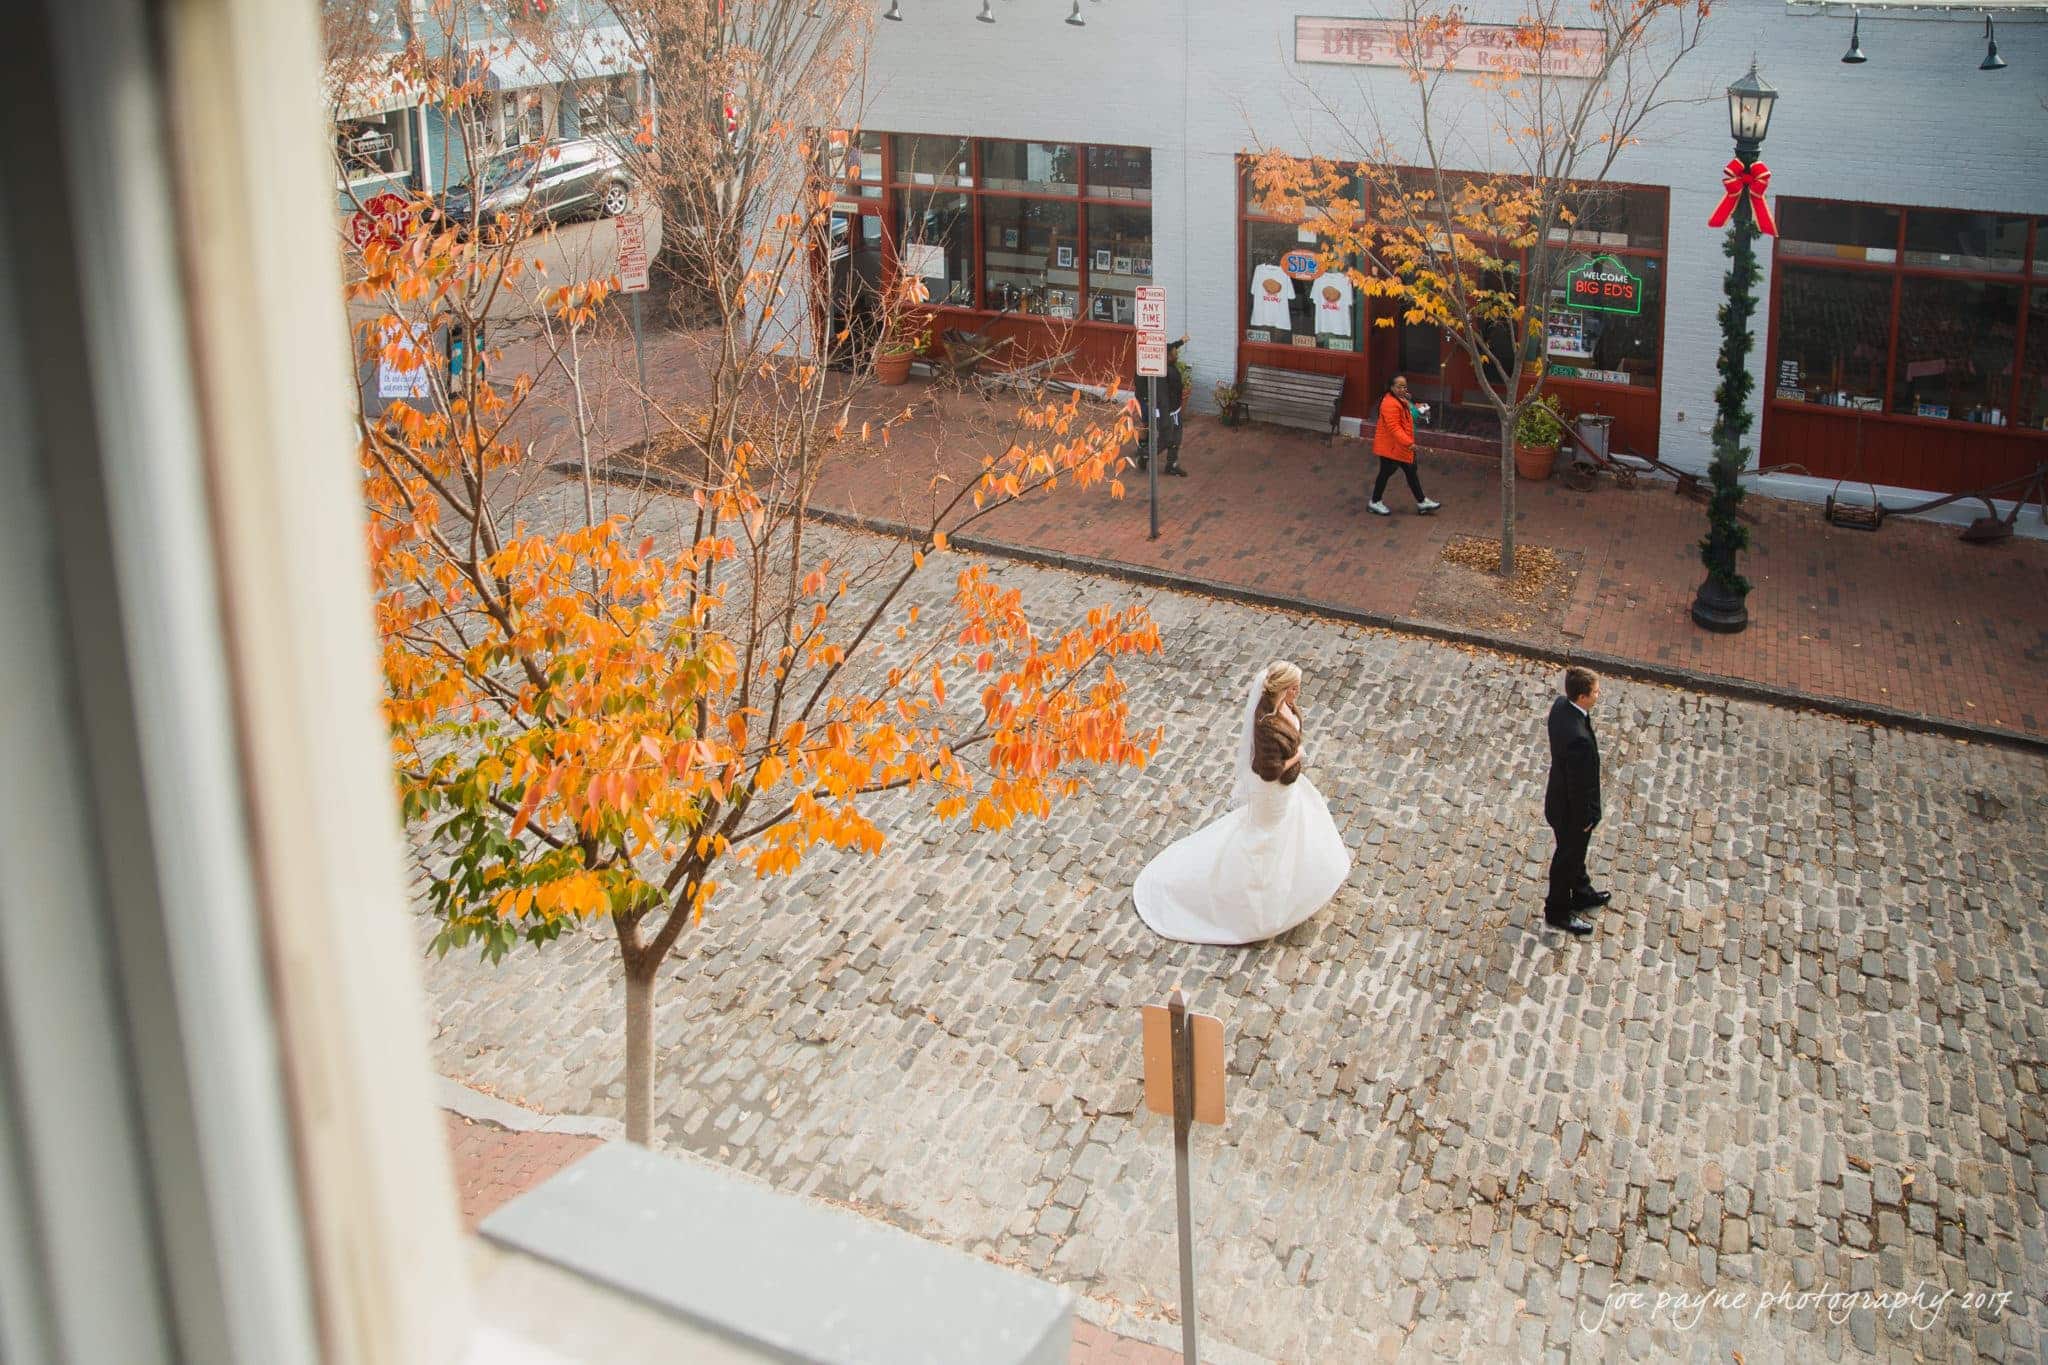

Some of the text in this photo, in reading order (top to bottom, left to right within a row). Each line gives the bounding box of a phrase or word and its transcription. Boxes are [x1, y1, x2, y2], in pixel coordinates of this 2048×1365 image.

[1321, 27, 1374, 61] Big
[1478, 51, 1568, 71] Rtauant
[357, 210, 410, 242] SOP
[1583, 271, 1628, 284] WELCOME
[1138, 289, 1146, 299] NO
[1575, 280, 1633, 299] BIG ED'S
[1143, 303, 1160, 313] ANY
[1142, 313, 1160, 323] TIME
